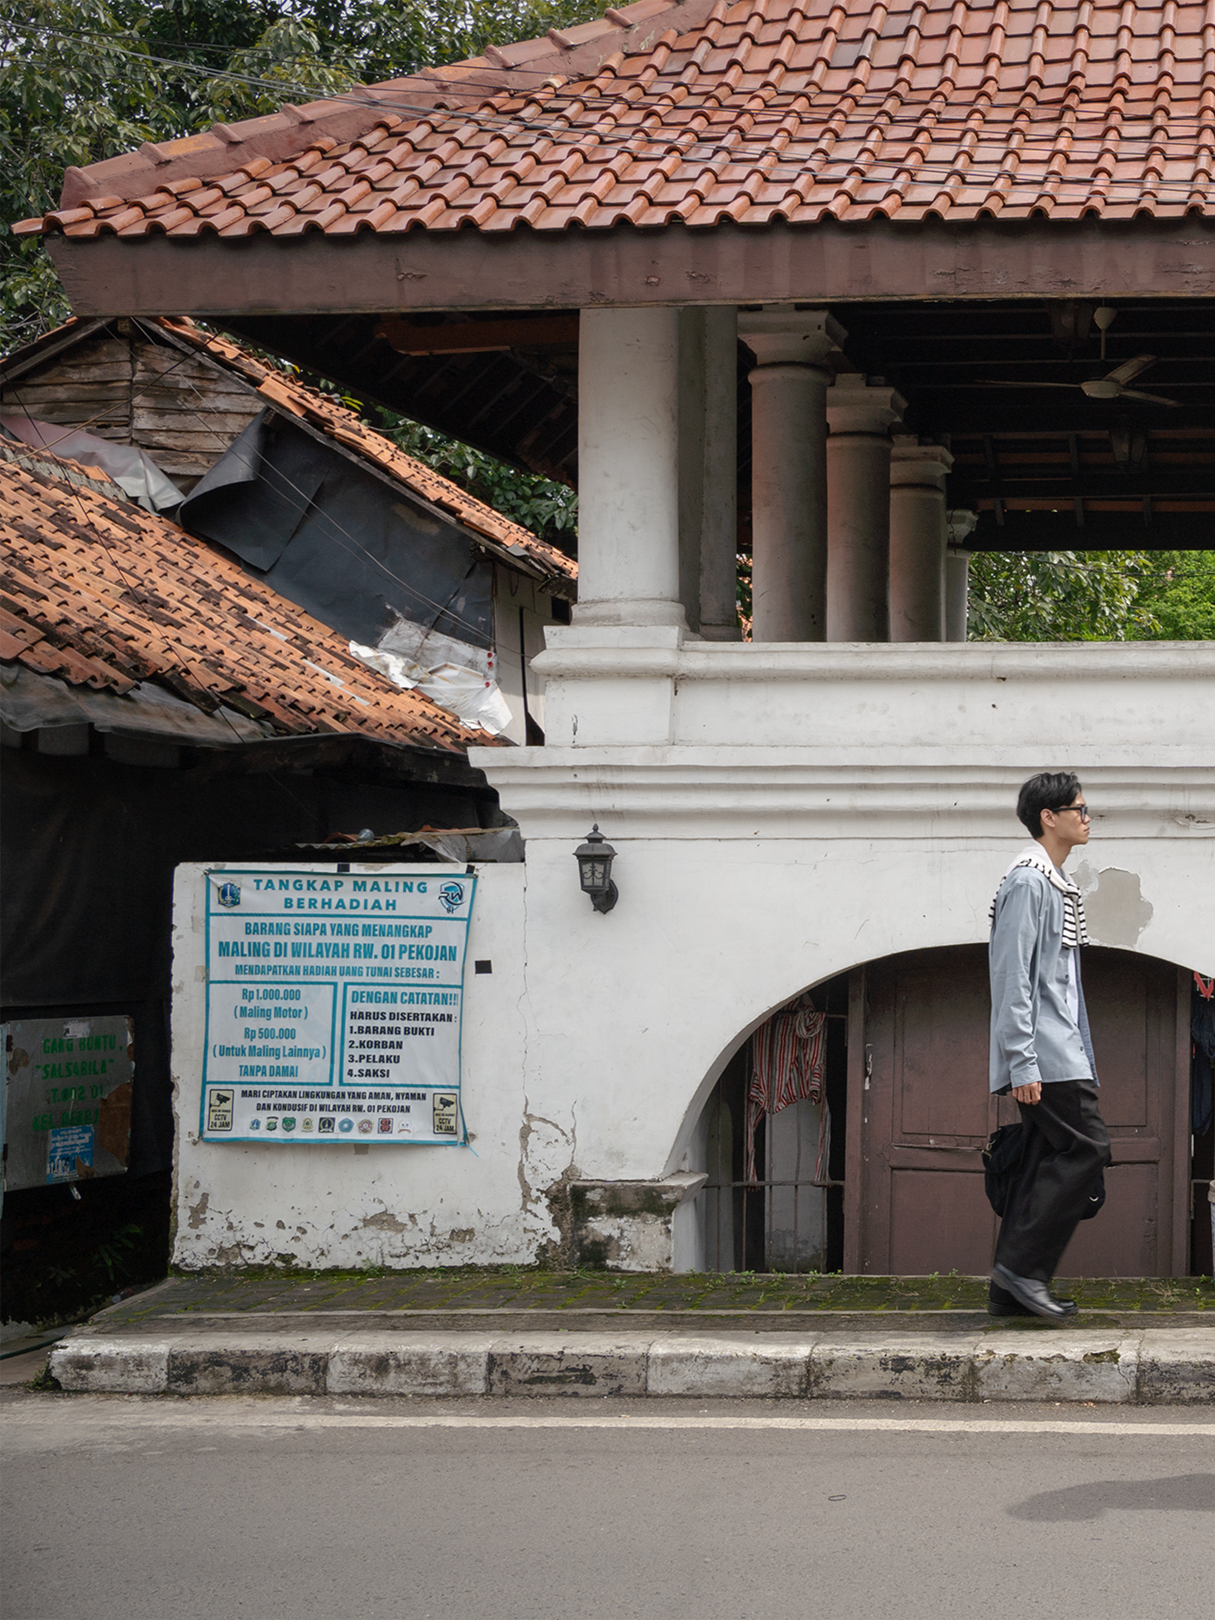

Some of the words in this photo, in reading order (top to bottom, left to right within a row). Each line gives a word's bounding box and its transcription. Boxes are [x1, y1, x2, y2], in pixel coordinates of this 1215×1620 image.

[253, 879, 344, 892] TANGKAP
[353, 880, 428, 893] MALING
[284, 897, 396, 911] BERHADIAH
[245, 922, 291, 936] BARANG
[293, 922, 327, 937] SIAPA
[330, 923, 359, 937] YANG
[362, 924, 433, 939] MENANGKAP
[218, 941, 271, 958] MALING
[274, 942, 288, 958] DI
[291, 942, 350, 959] WILAYAH
[353, 943, 378, 959] RW.
[381, 944, 396, 960] 01
[398, 945, 457, 961] PEKOJAN
[235, 964, 301, 977] MENDAPATKAN
[303, 965, 337, 977] HADIAH
[339, 965, 364, 977] UANG
[365, 966, 392, 978] TUNAI
[242, 988, 254, 1002] Rp
[256, 988, 301, 1001] 1.000.000
[351, 990, 398, 1004] DENGAN
[350, 1011, 387, 1020] HARUS
[244, 1027, 256, 1042] Rp
[258, 1028, 296, 1040] 500.000
[349, 1025, 402, 1036] 1.BARANG
[403, 1026, 435, 1036] BUKTI
[43, 1037, 74, 1054] GANG
[348, 1039, 403, 1050] 2.KORBAN
[248, 1045, 281, 1060] Maling
[348, 1054, 400, 1064] 3.PELAKU
[239, 1065, 267, 1077] TANPA
[269, 1065, 299, 1077] DAMAI
[347, 1068, 390, 1078] 4.SAKSI
[241, 1090, 261, 1098] MARI
[262, 1090, 297, 1099] CIPTAKAN
[299, 1090, 346, 1099] LINGKUNGAN
[347, 1091, 367, 1100] YANG
[368, 1091, 394, 1101] AMAN,
[395, 1092, 427, 1101] NYAMAN
[256, 1103, 271, 1111] DAN
[273, 1103, 308, 1112] KONDUSIF
[309, 1103, 317, 1112] DI
[319, 1104, 351, 1112] WILAYAH
[352, 1104, 366, 1113] RW.
[367, 1105, 376, 1113] 01
[377, 1105, 411, 1114] PEKOJAN
[214, 1113, 227, 1121] CCTV
[438, 1117, 452, 1125] CCTV
